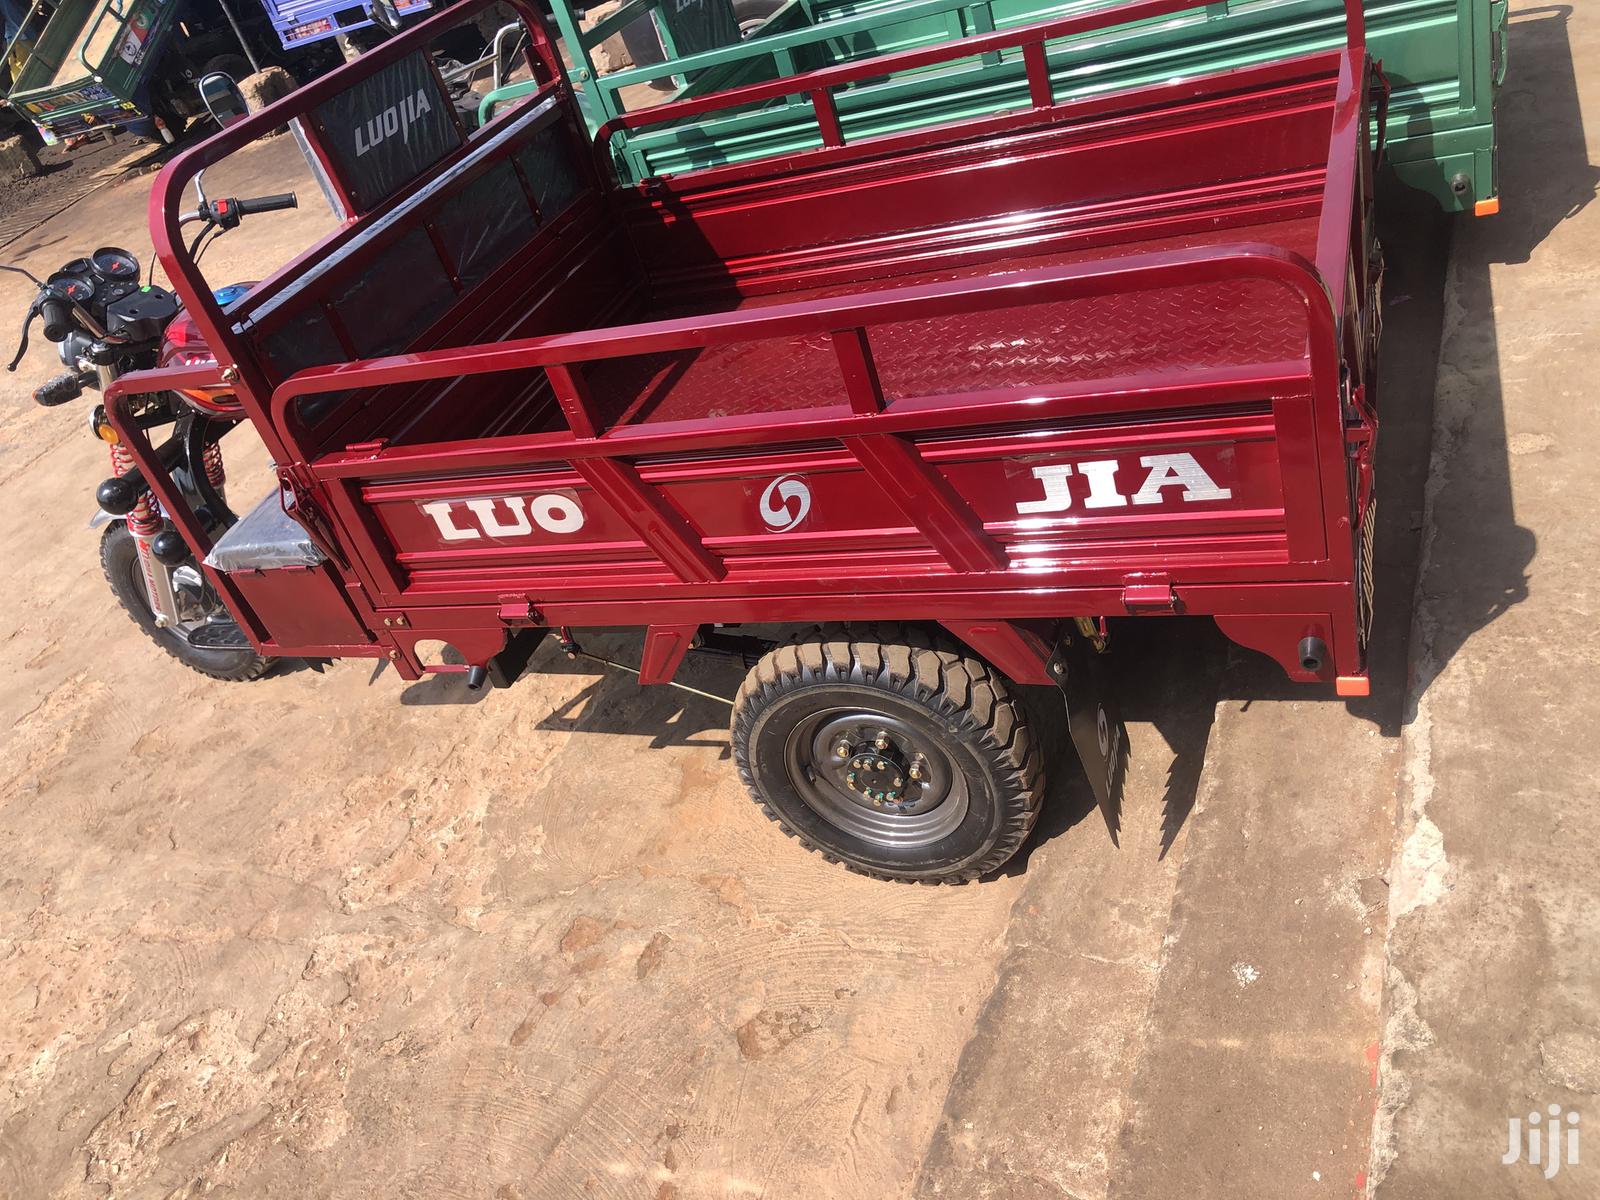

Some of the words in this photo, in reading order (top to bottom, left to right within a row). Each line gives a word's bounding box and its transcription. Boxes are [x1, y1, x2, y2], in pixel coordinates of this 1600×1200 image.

[354, 88, 432, 157] LUOJIA
[422, 494, 584, 541] LUO
[1015, 452, 1232, 514] JIA
